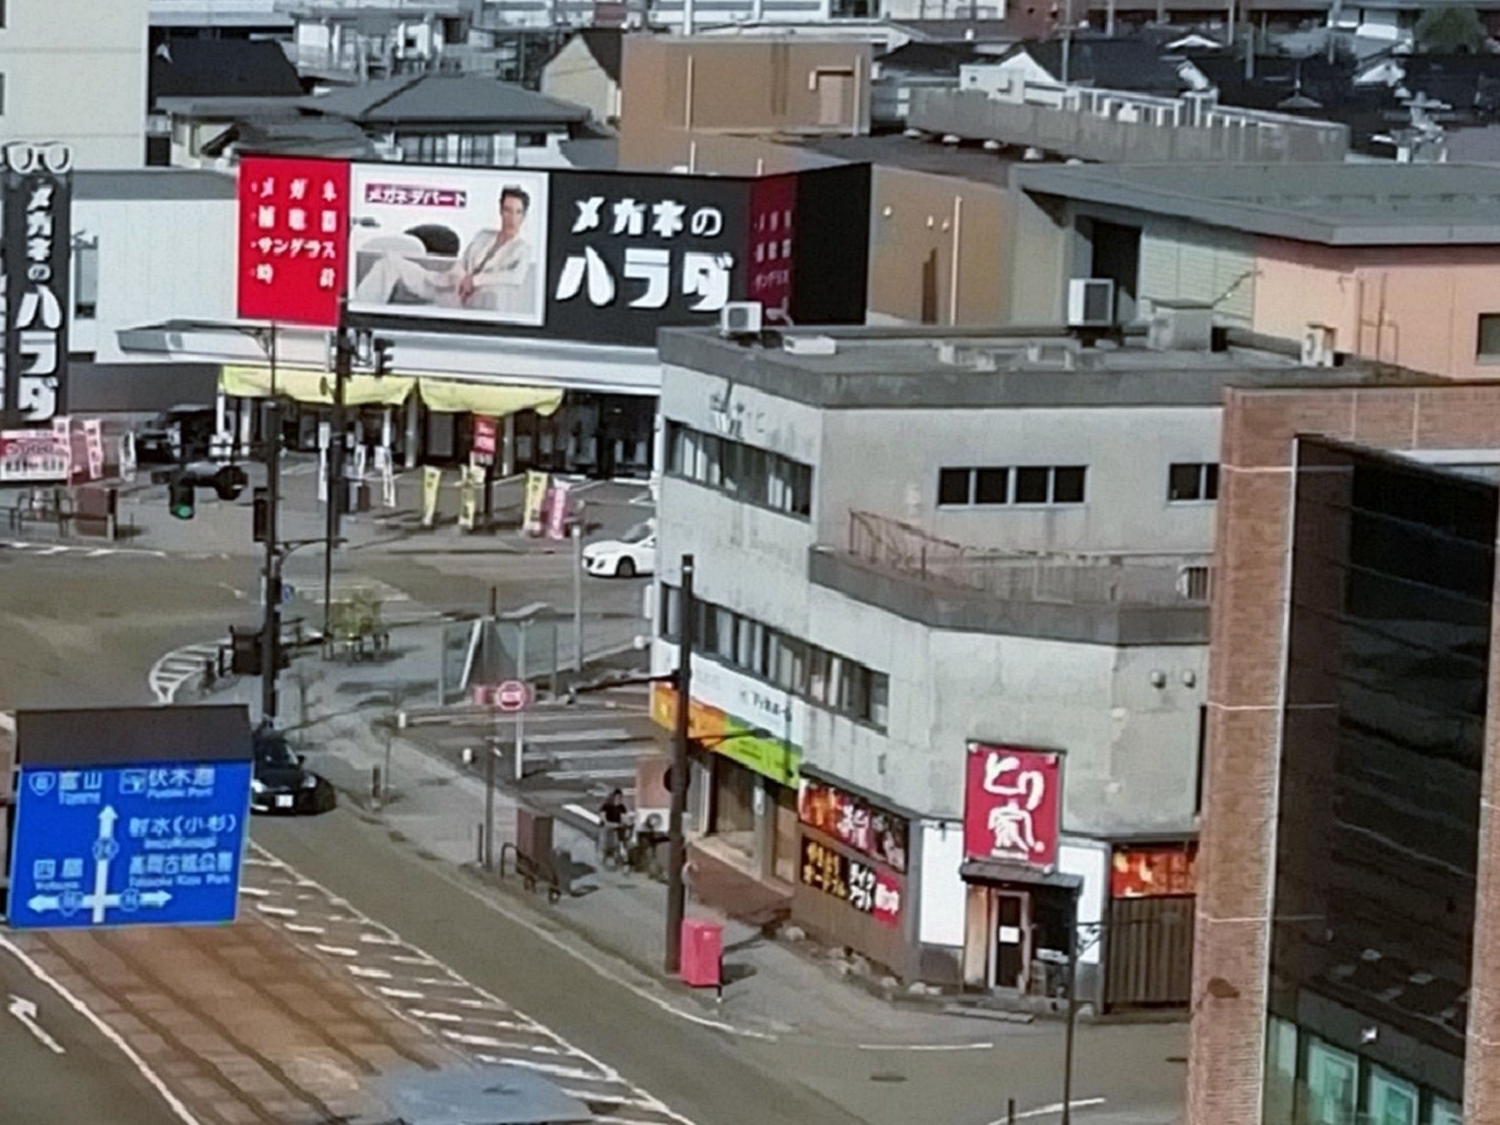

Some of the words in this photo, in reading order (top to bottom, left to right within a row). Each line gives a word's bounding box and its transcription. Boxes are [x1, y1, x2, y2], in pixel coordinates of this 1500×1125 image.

[260, 176, 337, 202] メガネ
[571, 196, 723, 238] メガネの
[257, 236, 337, 259] サングラス
[555, 245, 734, 312] ハラダ
[14, 185, 63, 422] メガネのハラダ
